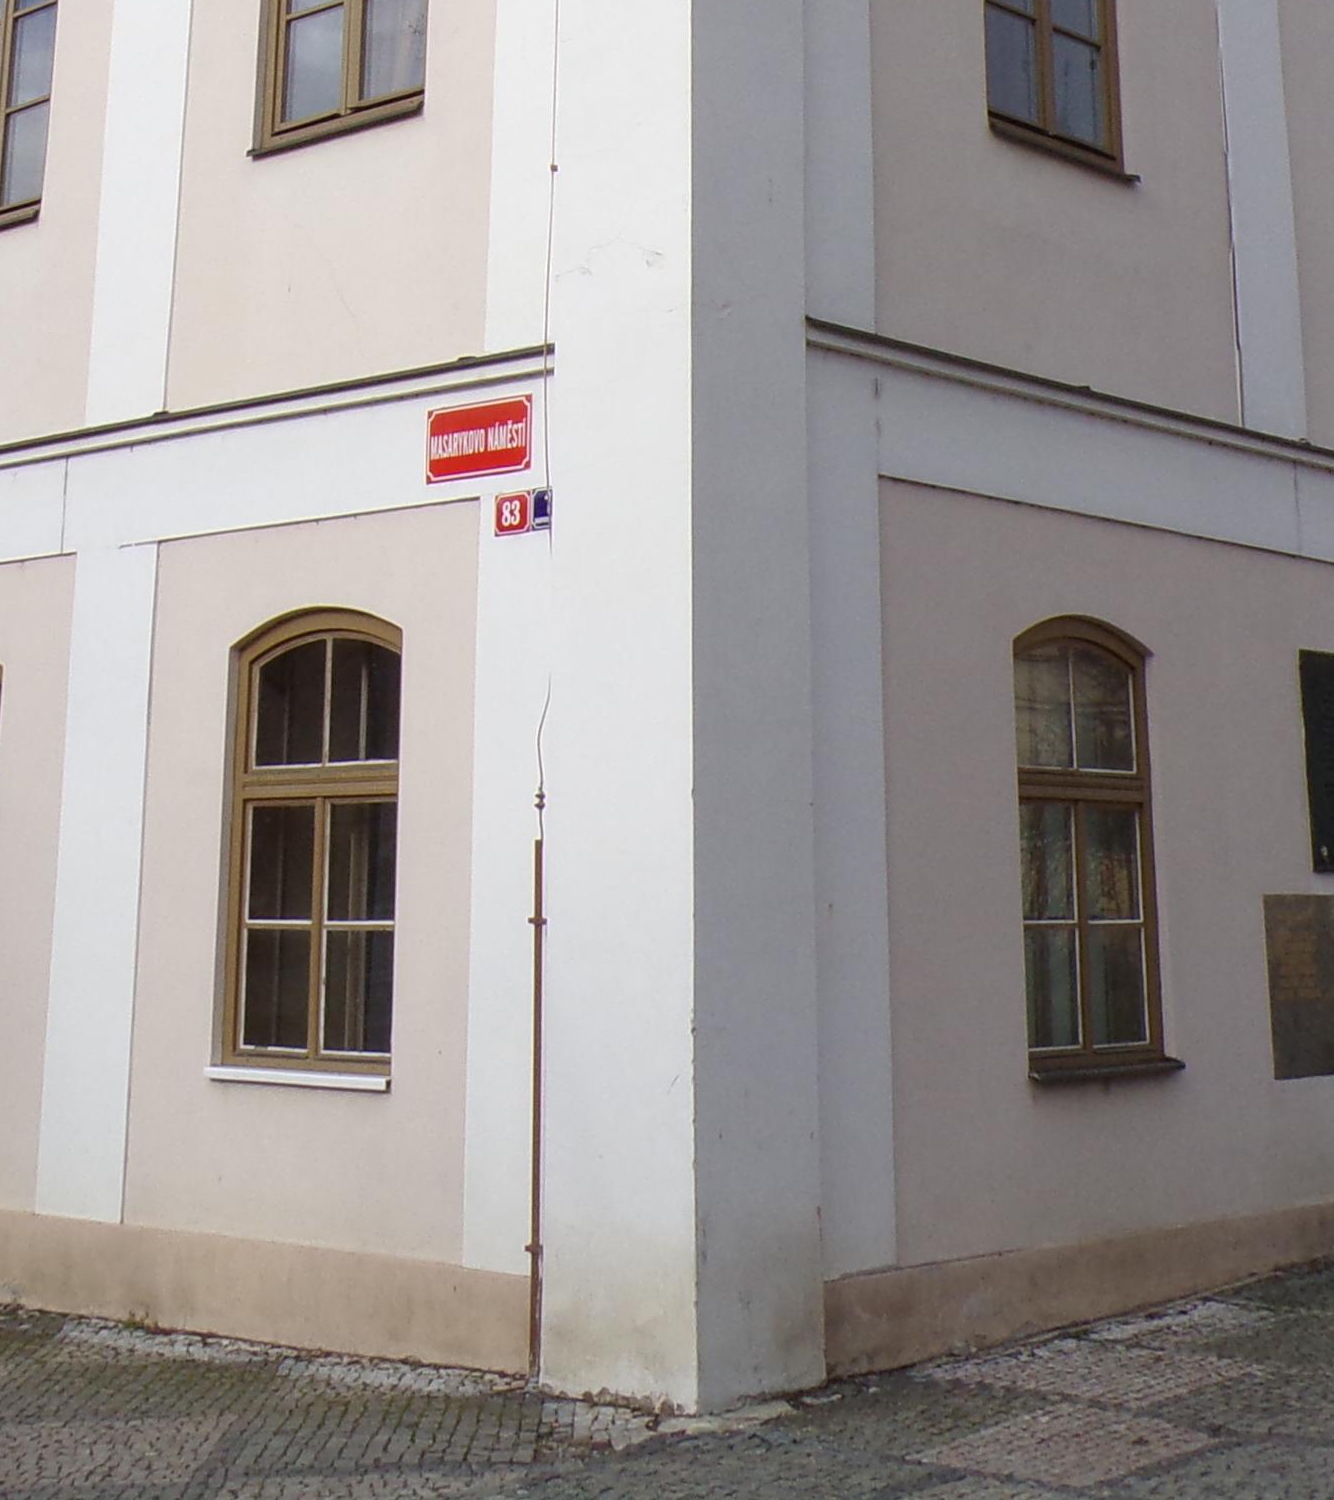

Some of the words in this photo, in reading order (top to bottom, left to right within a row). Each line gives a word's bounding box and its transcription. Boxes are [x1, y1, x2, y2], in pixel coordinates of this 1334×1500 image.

[430, 428, 486, 461] MASARYKOVO
[487, 417, 526, 452] NÁMĚSTÍ
[501, 500, 521, 527] 83
